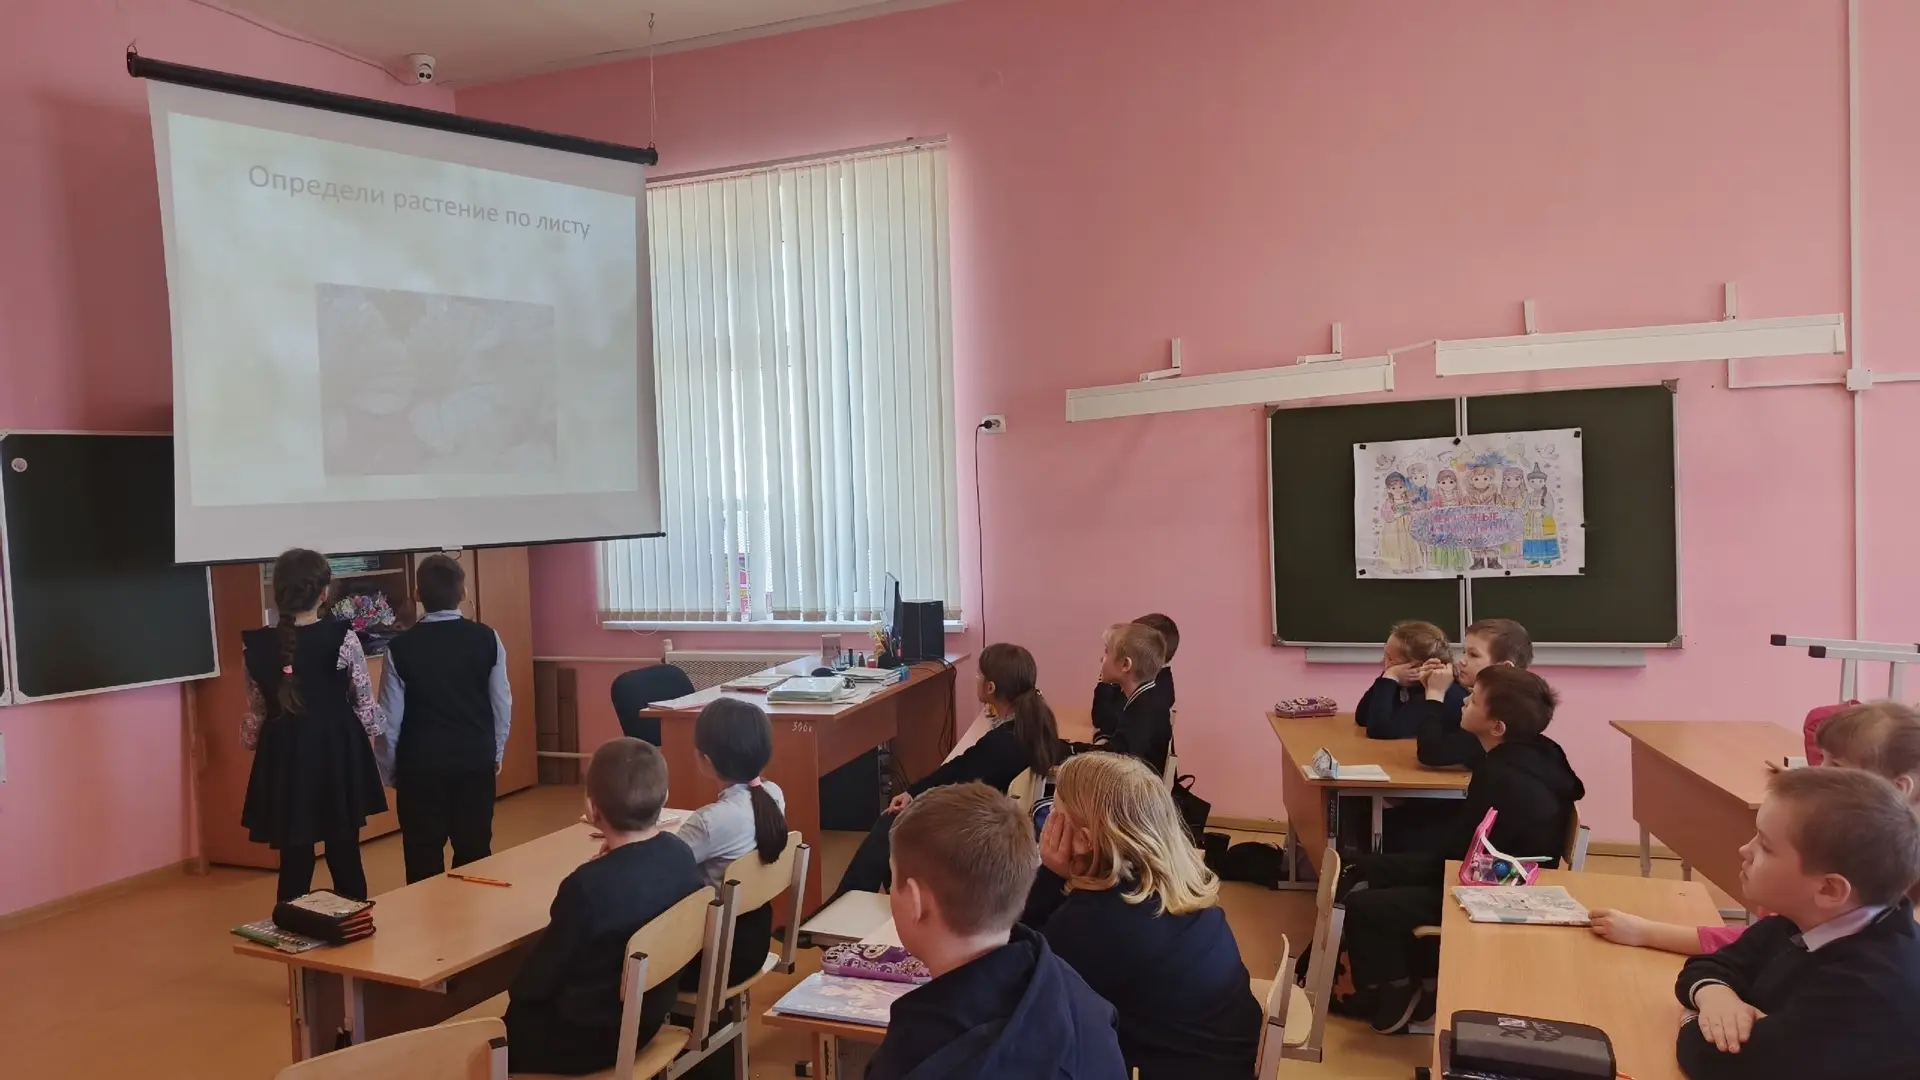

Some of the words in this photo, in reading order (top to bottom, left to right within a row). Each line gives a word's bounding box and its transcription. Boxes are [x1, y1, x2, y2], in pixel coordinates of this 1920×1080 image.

[248, 164, 385, 205] Определи
[393, 190, 499, 222] растение
[505, 209, 531, 228] по
[537, 214, 591, 240] листу
